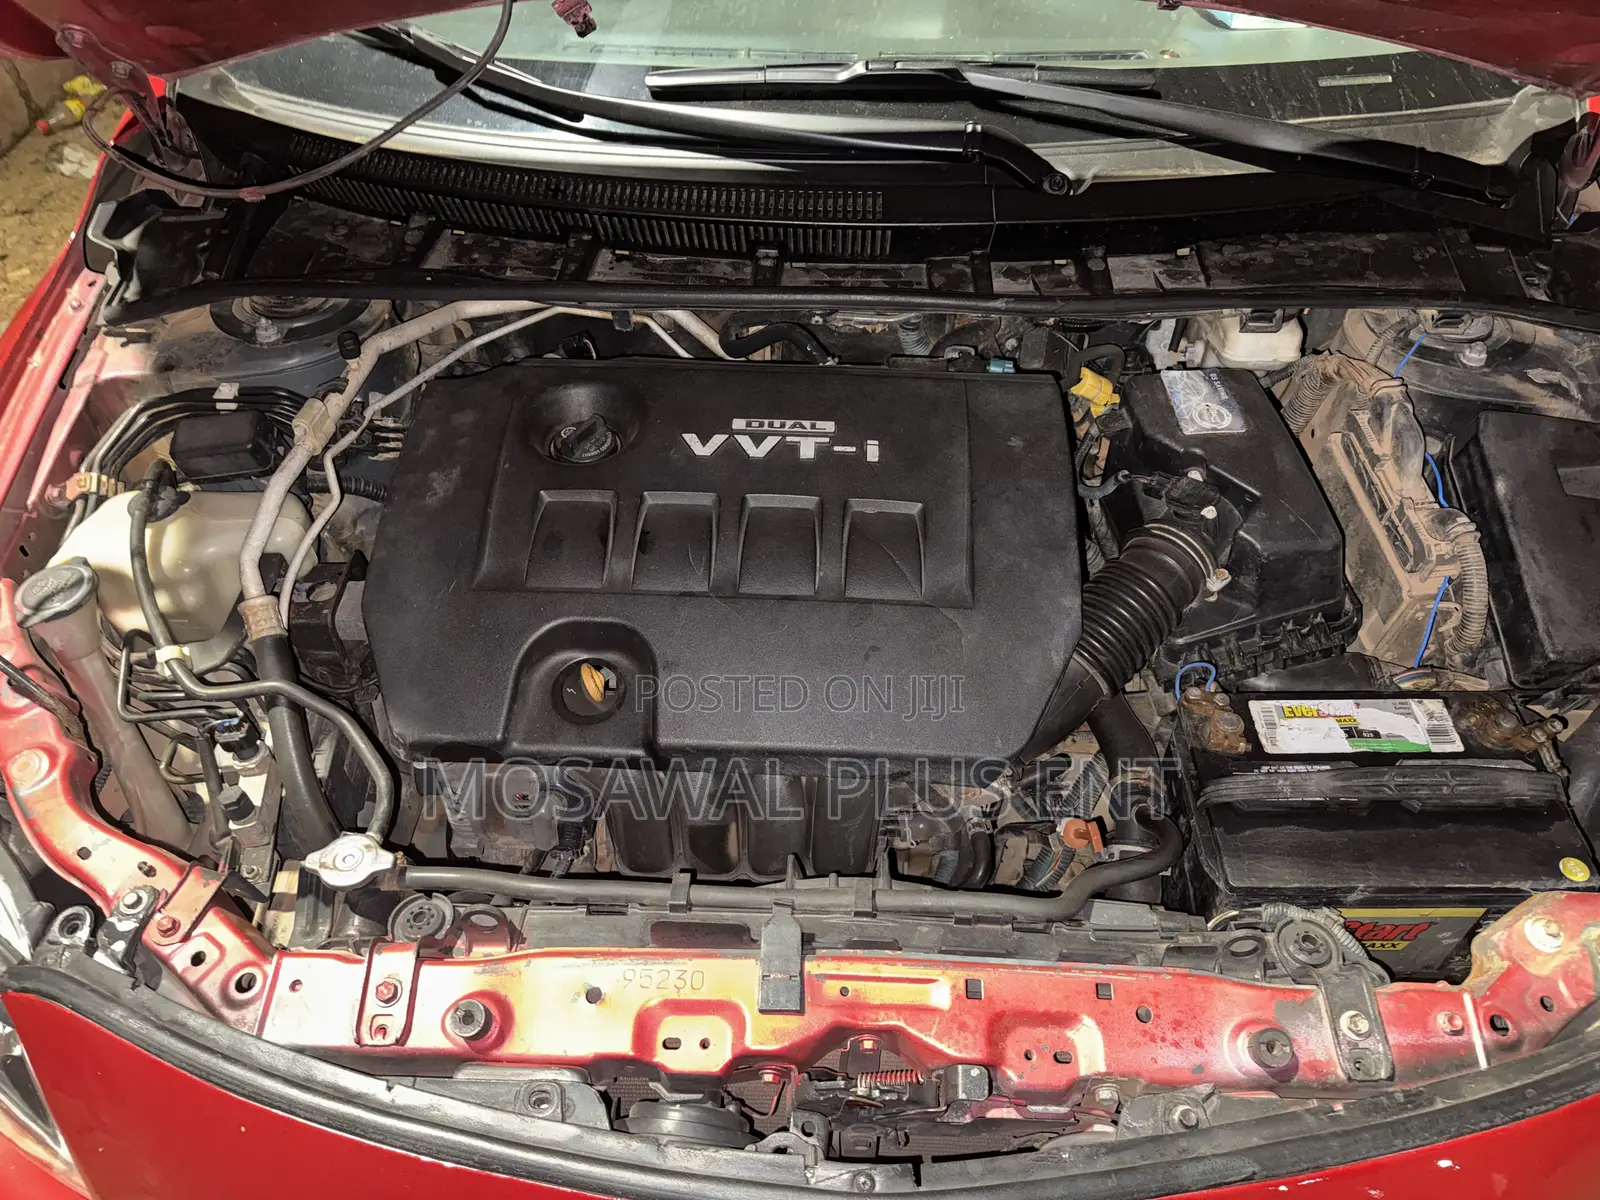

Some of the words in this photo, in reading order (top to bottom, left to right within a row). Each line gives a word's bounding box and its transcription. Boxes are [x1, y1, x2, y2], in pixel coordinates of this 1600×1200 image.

[745, 419, 827, 430] DUAL
[681, 433, 879, 462] VVT-i
[623, 968, 705, 991] 95230
